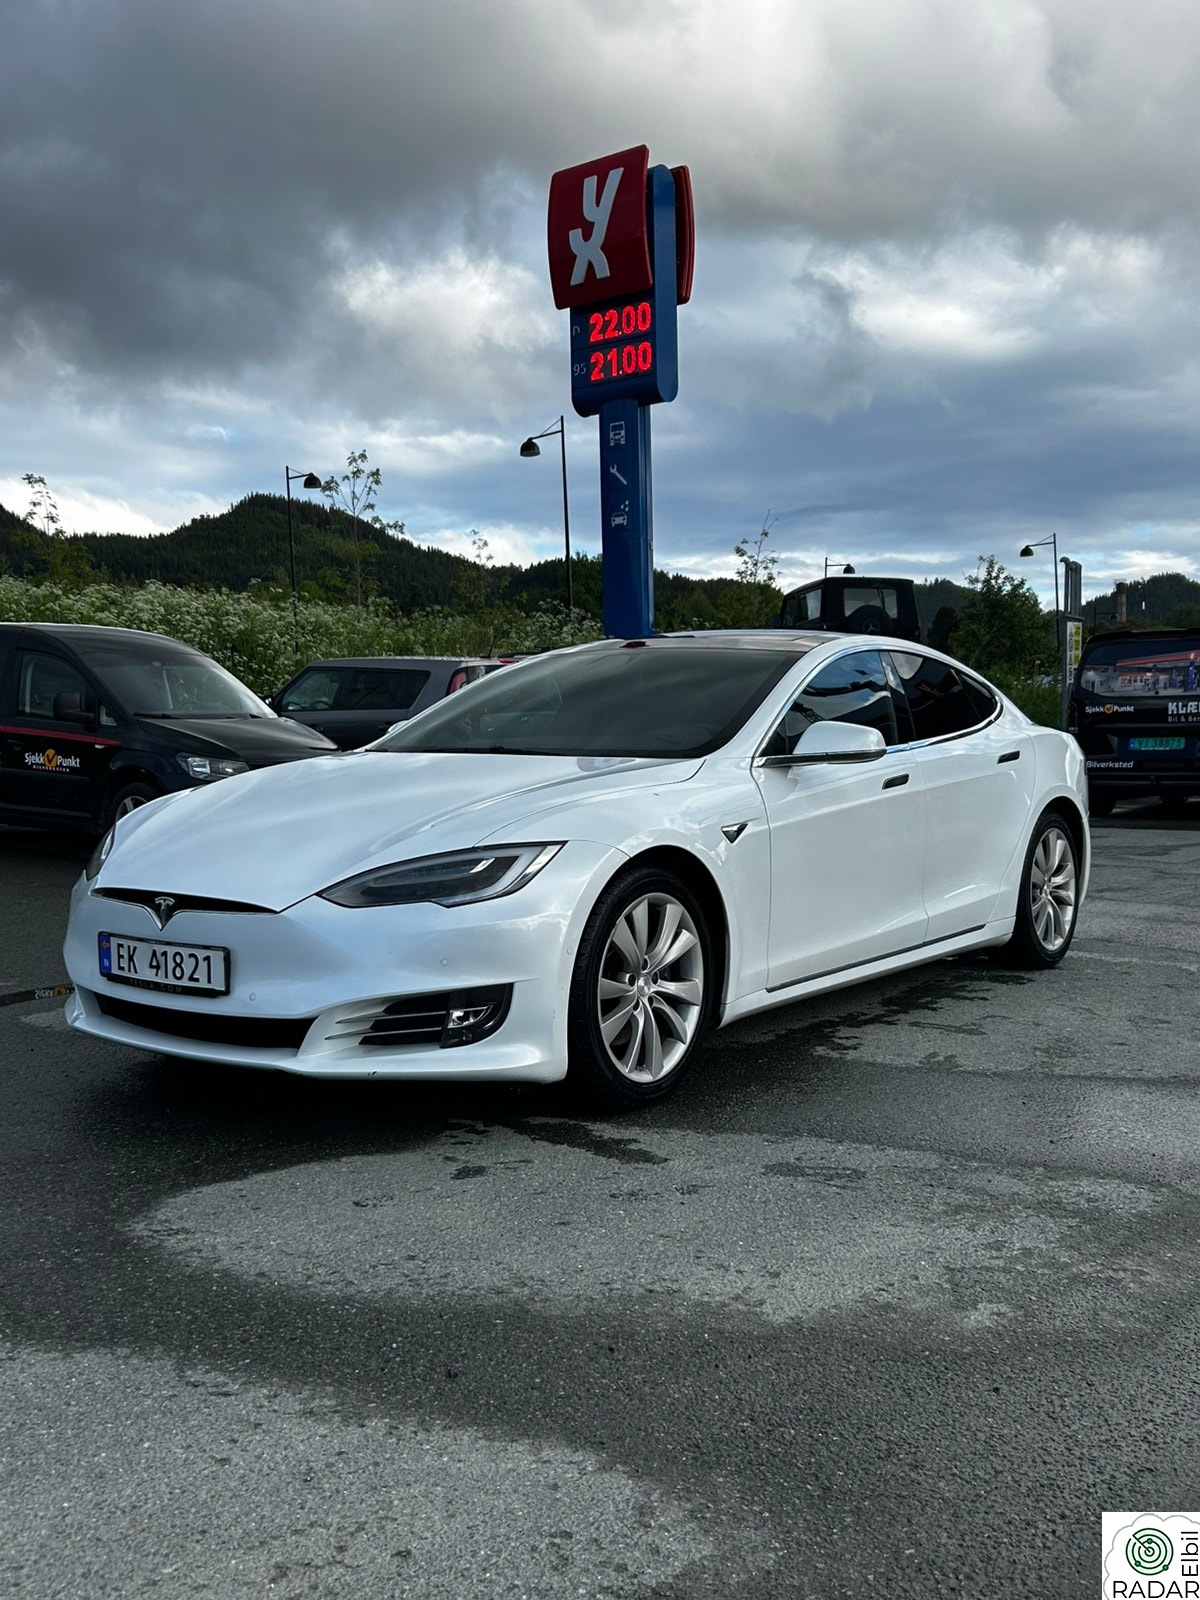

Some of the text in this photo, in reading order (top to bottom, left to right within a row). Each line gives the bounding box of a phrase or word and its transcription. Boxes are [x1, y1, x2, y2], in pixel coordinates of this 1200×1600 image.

[589, 301, 652, 342] 22.00
[573, 341, 652, 381] 95 21.00
[1085, 705, 1104, 714] Sjekk
[1168, 702, 1200, 714] KLÆ
[24, 752, 80, 768] Sjekk Punkt
[1086, 760, 1134, 768] Bilverksted
[103, 942, 213, 985] N EK 41821
